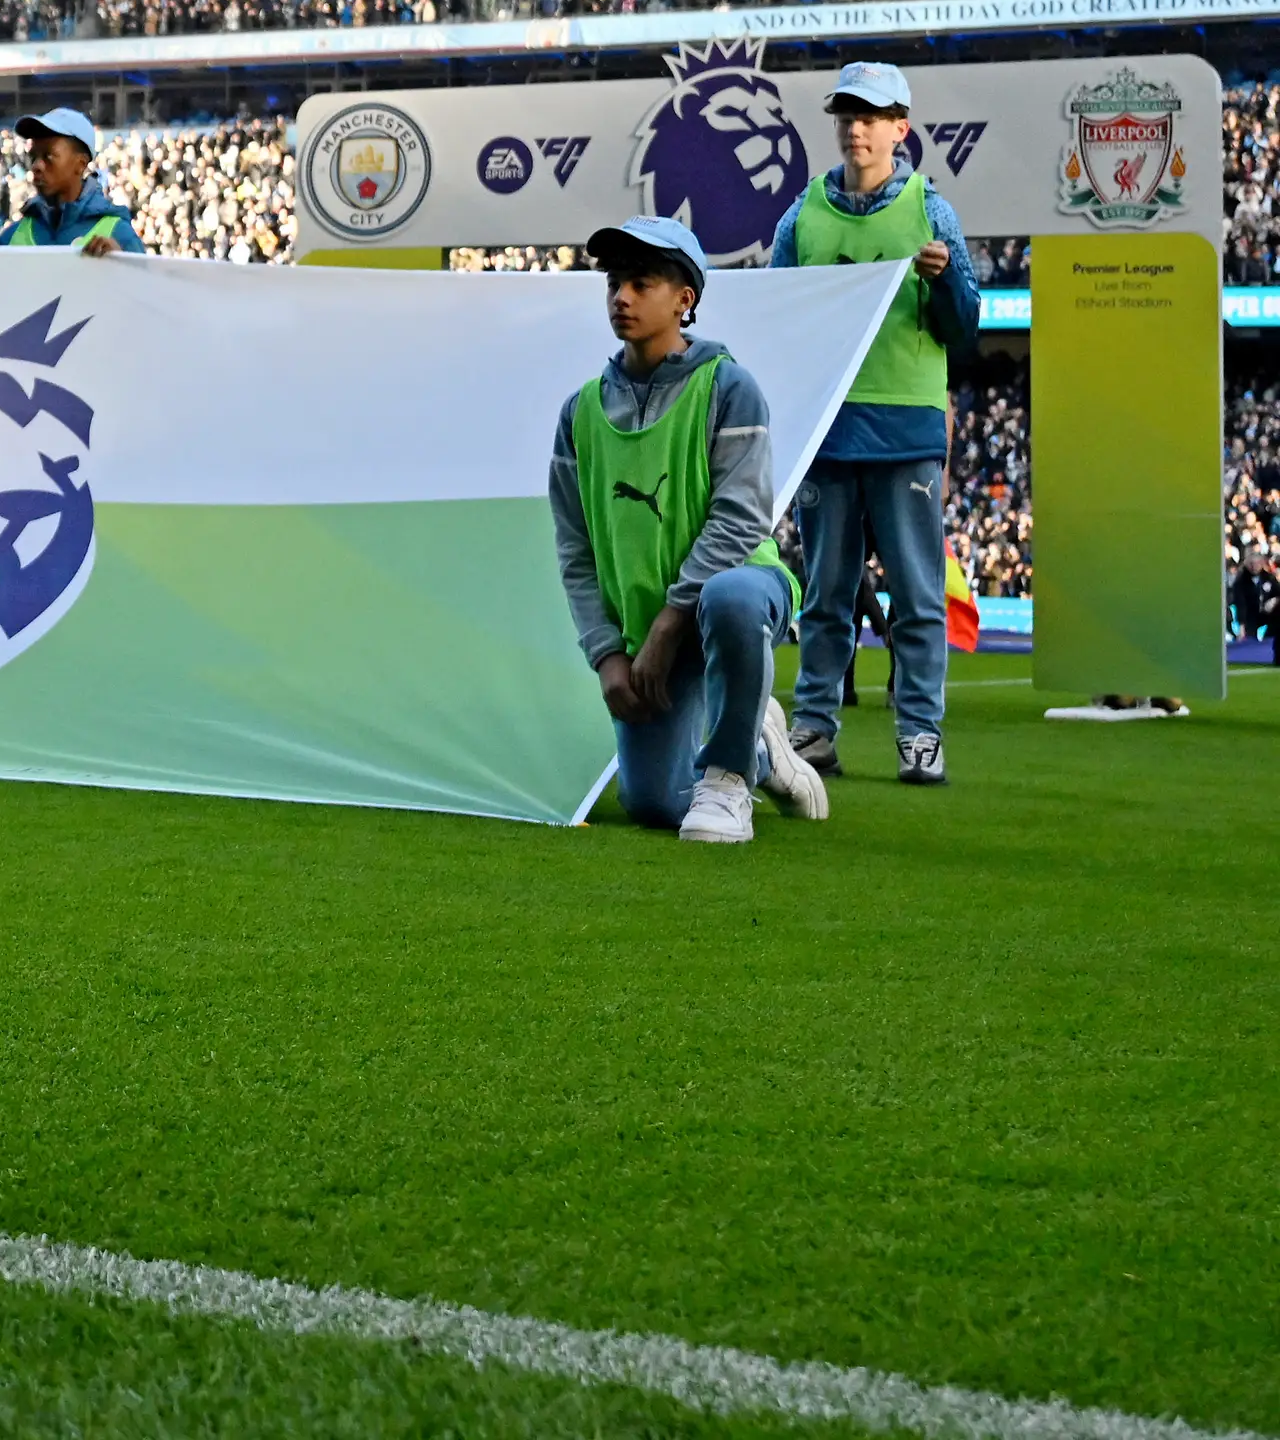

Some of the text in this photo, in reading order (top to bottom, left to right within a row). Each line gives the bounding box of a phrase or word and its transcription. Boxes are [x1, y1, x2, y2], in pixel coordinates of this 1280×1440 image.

[741, 11, 783, 30] AND
[792, 11, 822, 28] ON
[831, 9, 871, 26] THE
[880, 5, 952, 25] SIXTH
[959, 1, 1005, 20] DAY
[320, 113, 417, 154] MANCHESTER
[1085, 126, 1166, 140] LIVERPOOL
[487, 147, 523, 168] EA
[485, 169, 524, 180] SPORTS
[350, 213, 384, 227] CITY
[1073, 262, 1174, 277] Premier League
